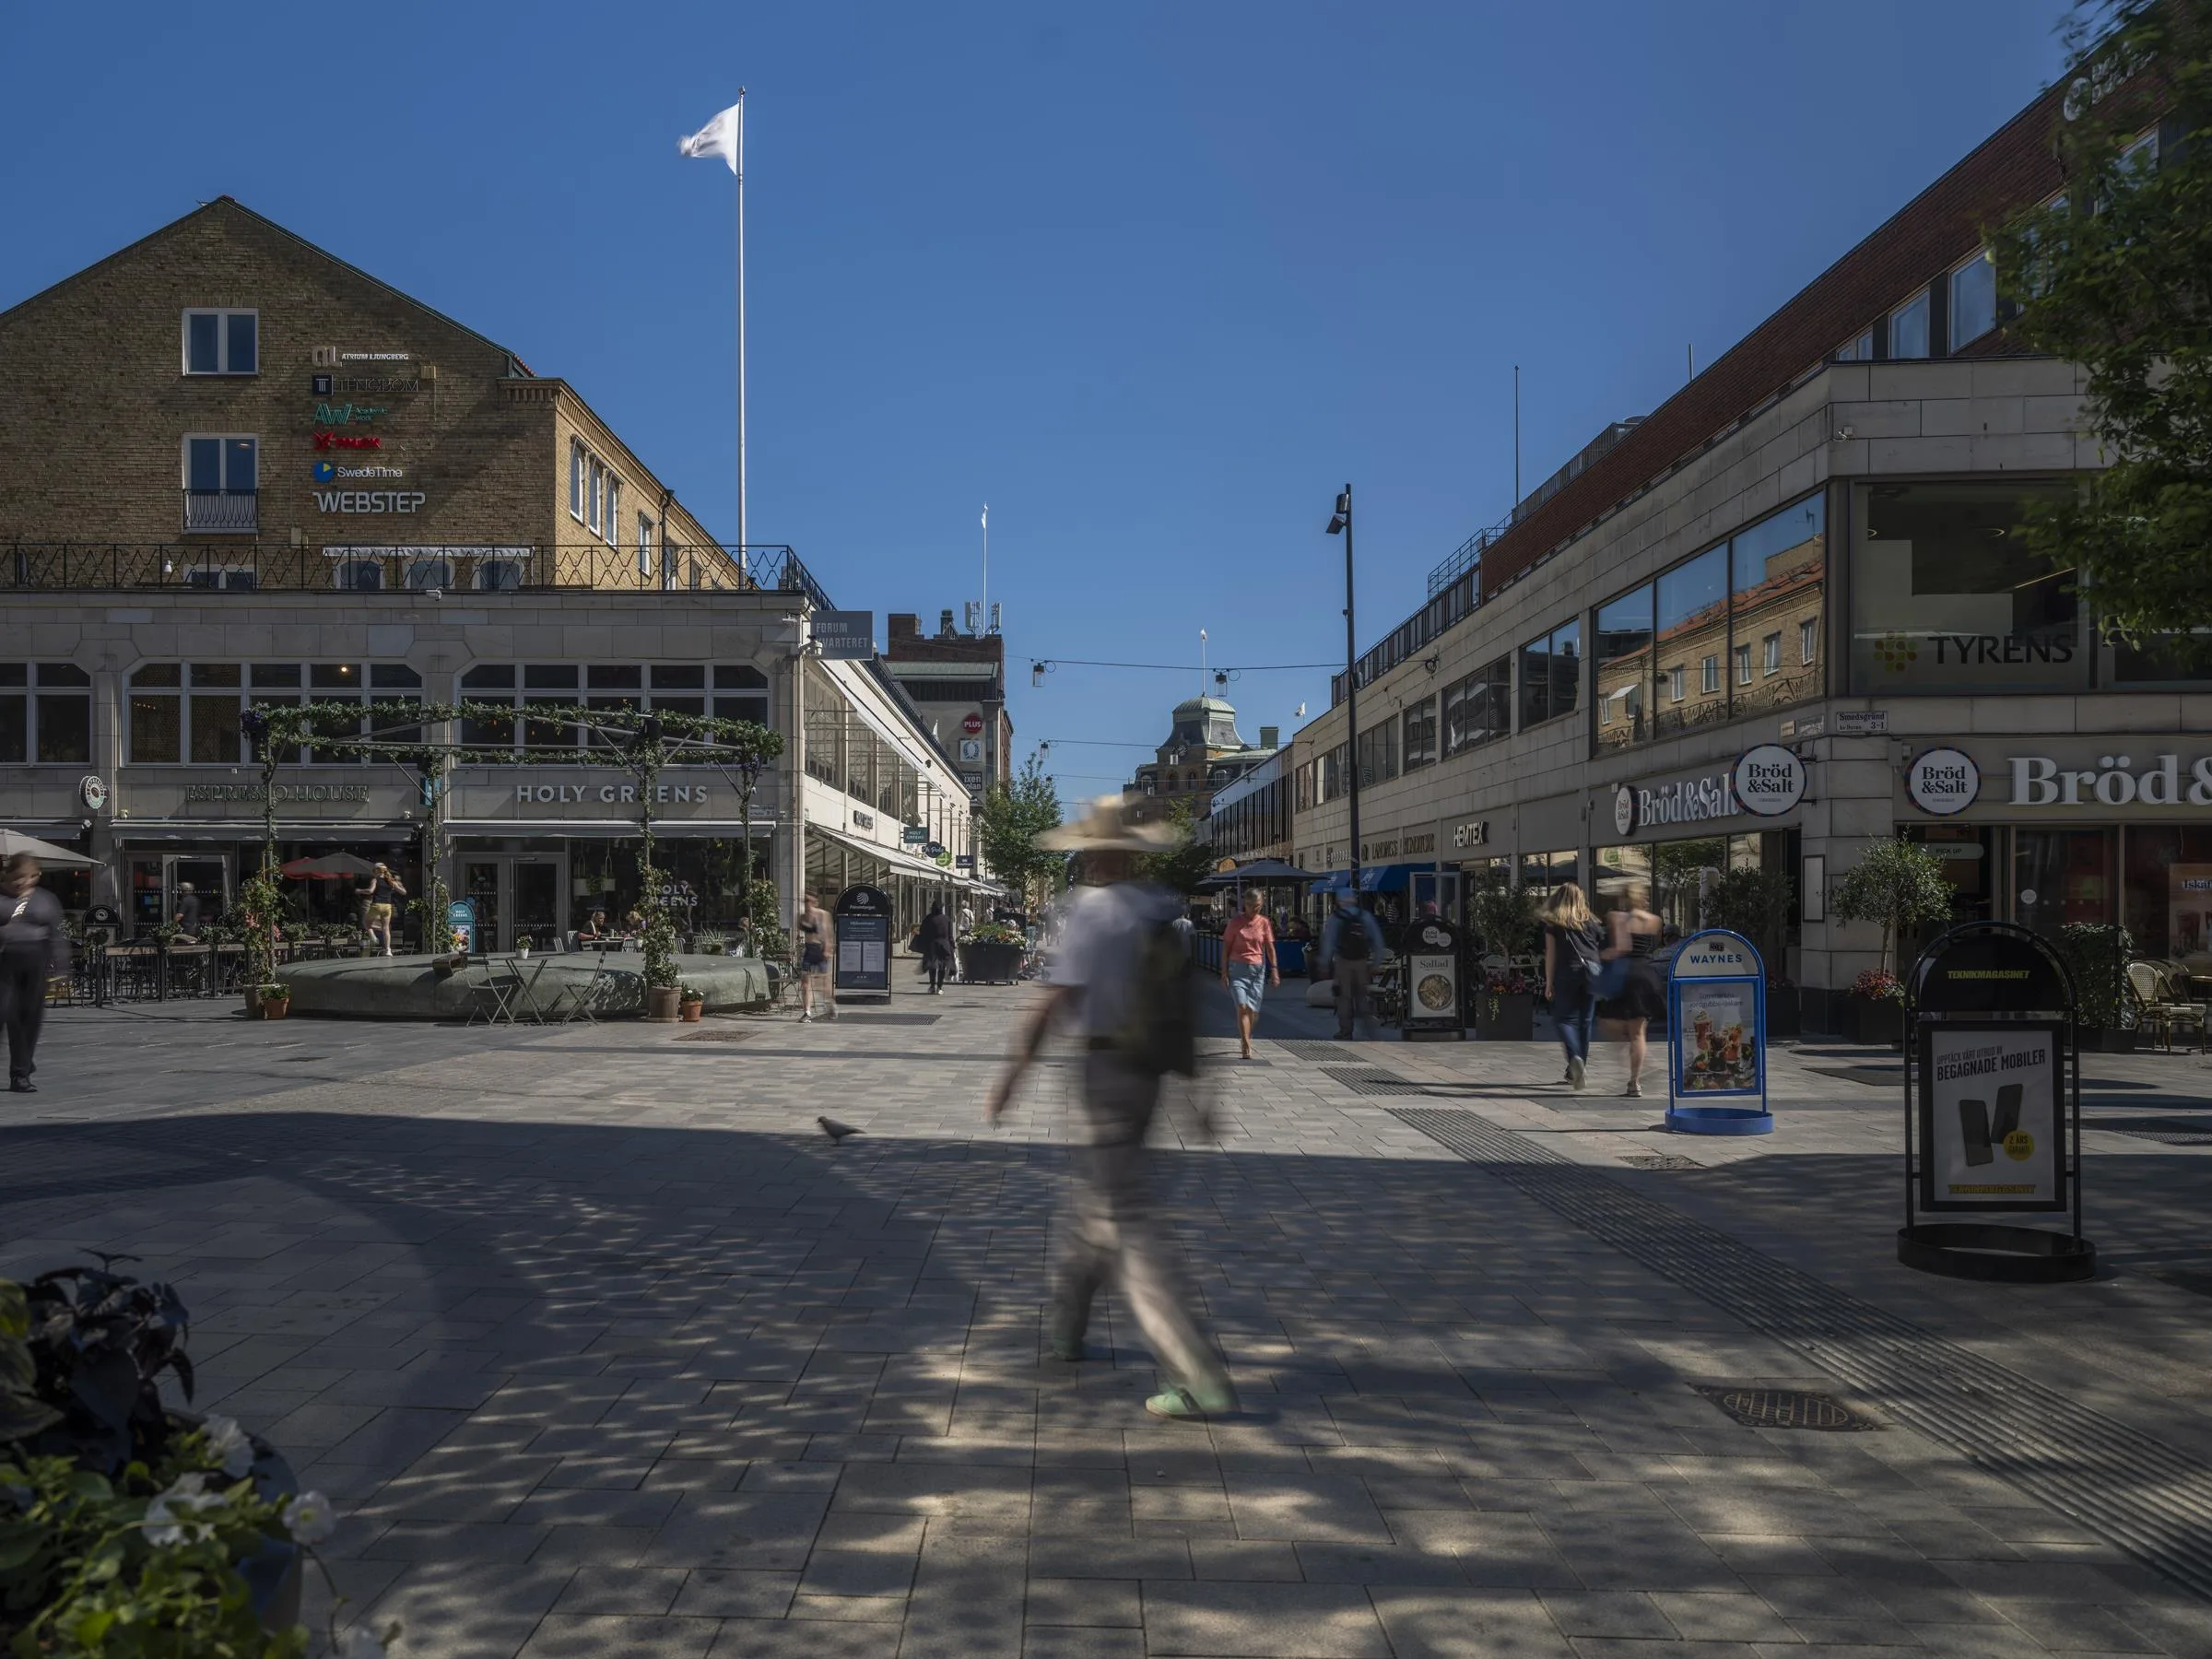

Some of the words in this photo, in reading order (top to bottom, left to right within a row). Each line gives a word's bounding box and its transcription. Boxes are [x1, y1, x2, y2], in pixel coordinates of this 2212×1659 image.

[337, 466, 403, 477] SwedeTime
[312, 491, 426, 513] WEBSTEP
[816, 622, 848, 633] FORUM
[818, 638, 868, 649] VARTERET
[964, 721, 982, 729] PLUS
[1870, 722, 1885, 730] 3-1
[1747, 763, 1792, 778] Bröd
[1922, 766, 1966, 779] Bröd
[295, 784, 369, 802] HOUSE
[1747, 779, 1794, 794] &Salt
[1922, 781, 1968, 794] &Salt
[517, 785, 587, 804] HOLY
[599, 785, 709, 804] GRENS
[1453, 821, 1484, 847] HEMTEX
[662, 885, 690, 895] OLY
[1418, 959, 1450, 969] Sallad
[1689, 954, 1743, 964] WAYNES
[1946, 971, 2030, 980] TEKNIKMAGASINET
[1937, 1057, 1998, 1081] BEGAGNADE
[2001, 1049, 2046, 1071] MOBILER
